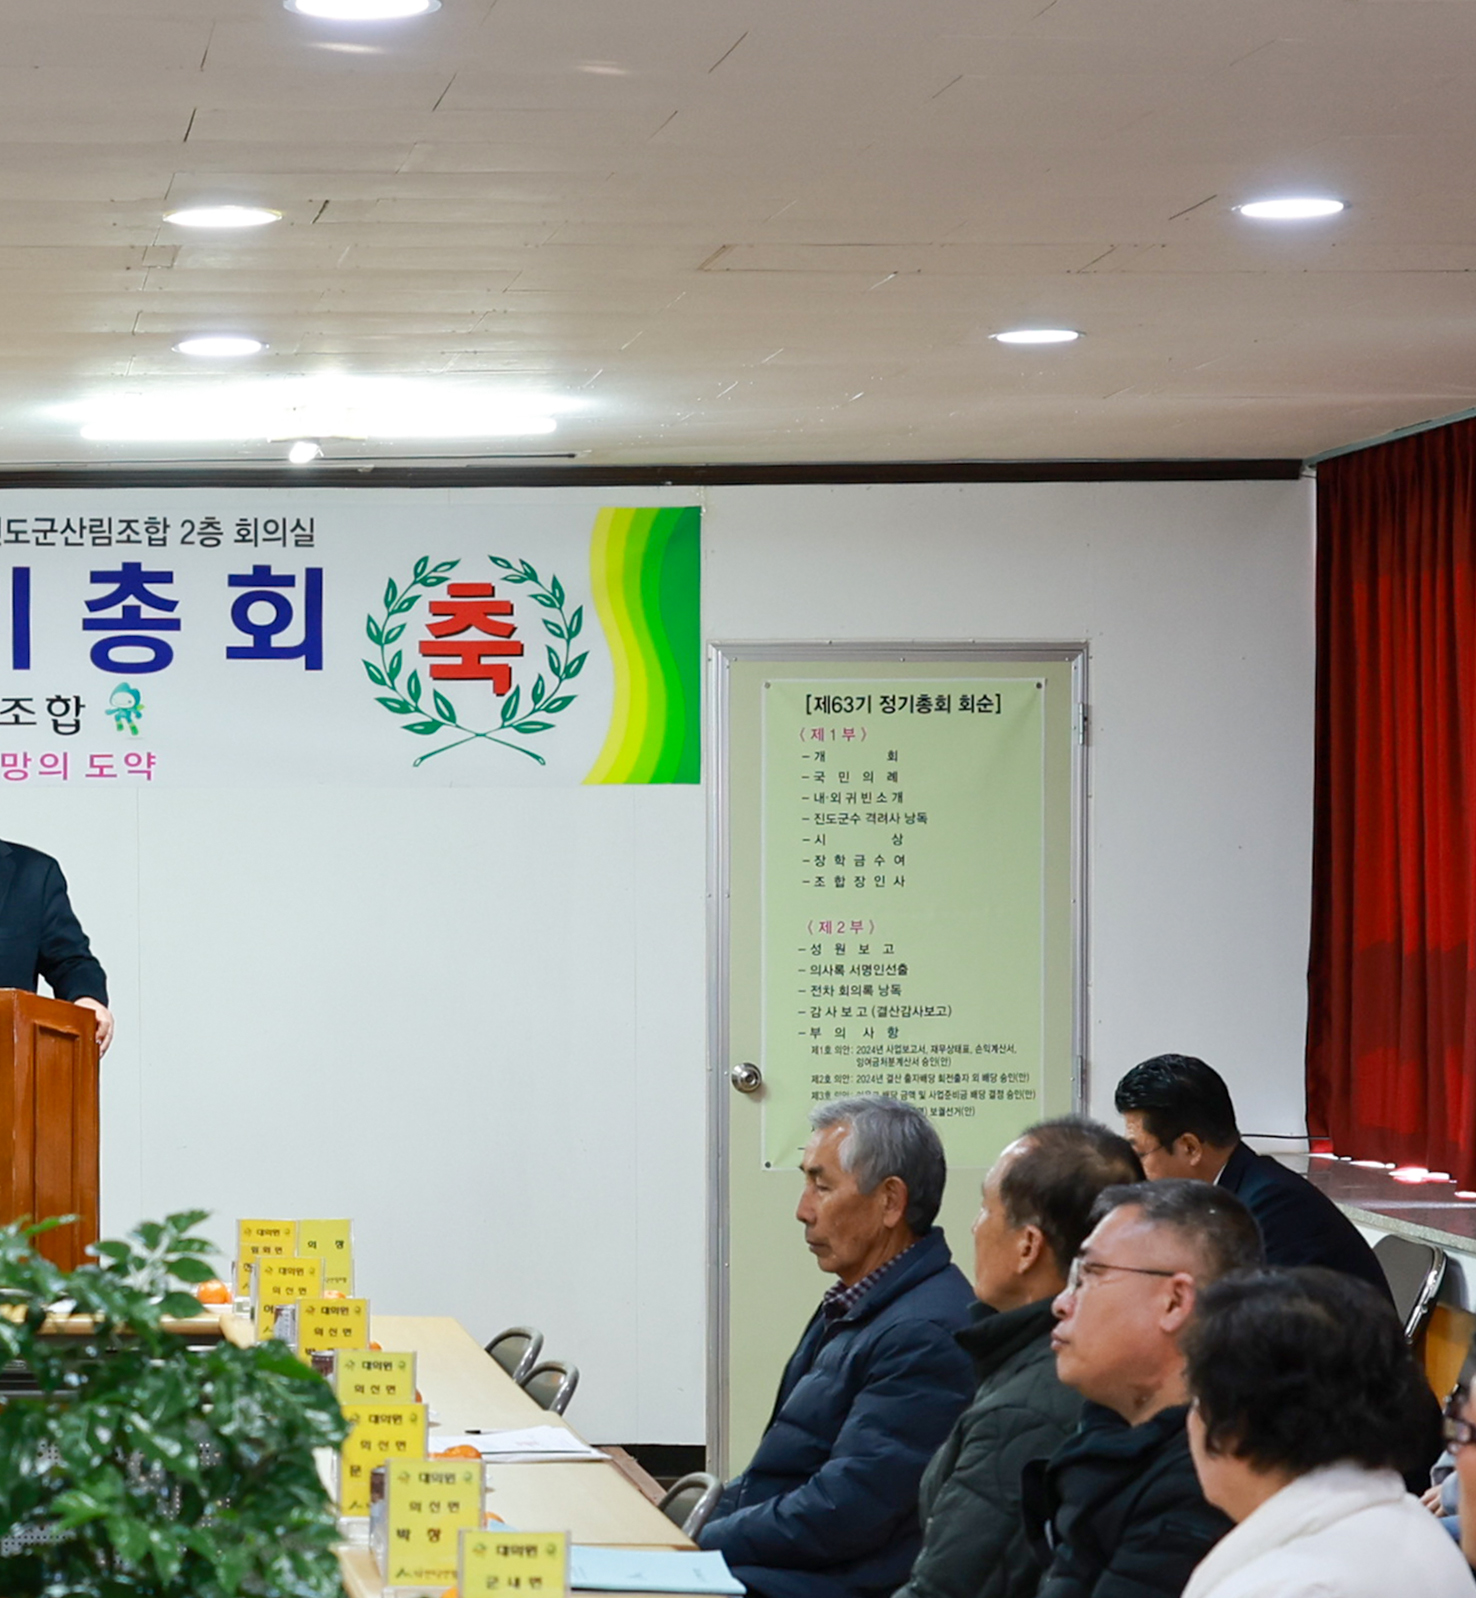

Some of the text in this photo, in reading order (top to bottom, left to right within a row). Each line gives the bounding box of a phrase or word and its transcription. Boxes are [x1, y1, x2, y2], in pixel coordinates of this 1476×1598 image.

[181, 517, 223, 548] 2층
[234, 518, 314, 547] 회의실
[418, 582, 524, 696] 축
[805, 693, 1001, 715] [제63기 정기총회 회순]
[85, 752, 156, 781] 도약
[814, 811, 928, 826] 진도군수 격려사 낭독
[810, 963, 908, 977] 의사록 서명인선출
[810, 983, 902, 998] 전차 회의록 낭독
[871, 1005, 952, 1018] (결산감사보고)
